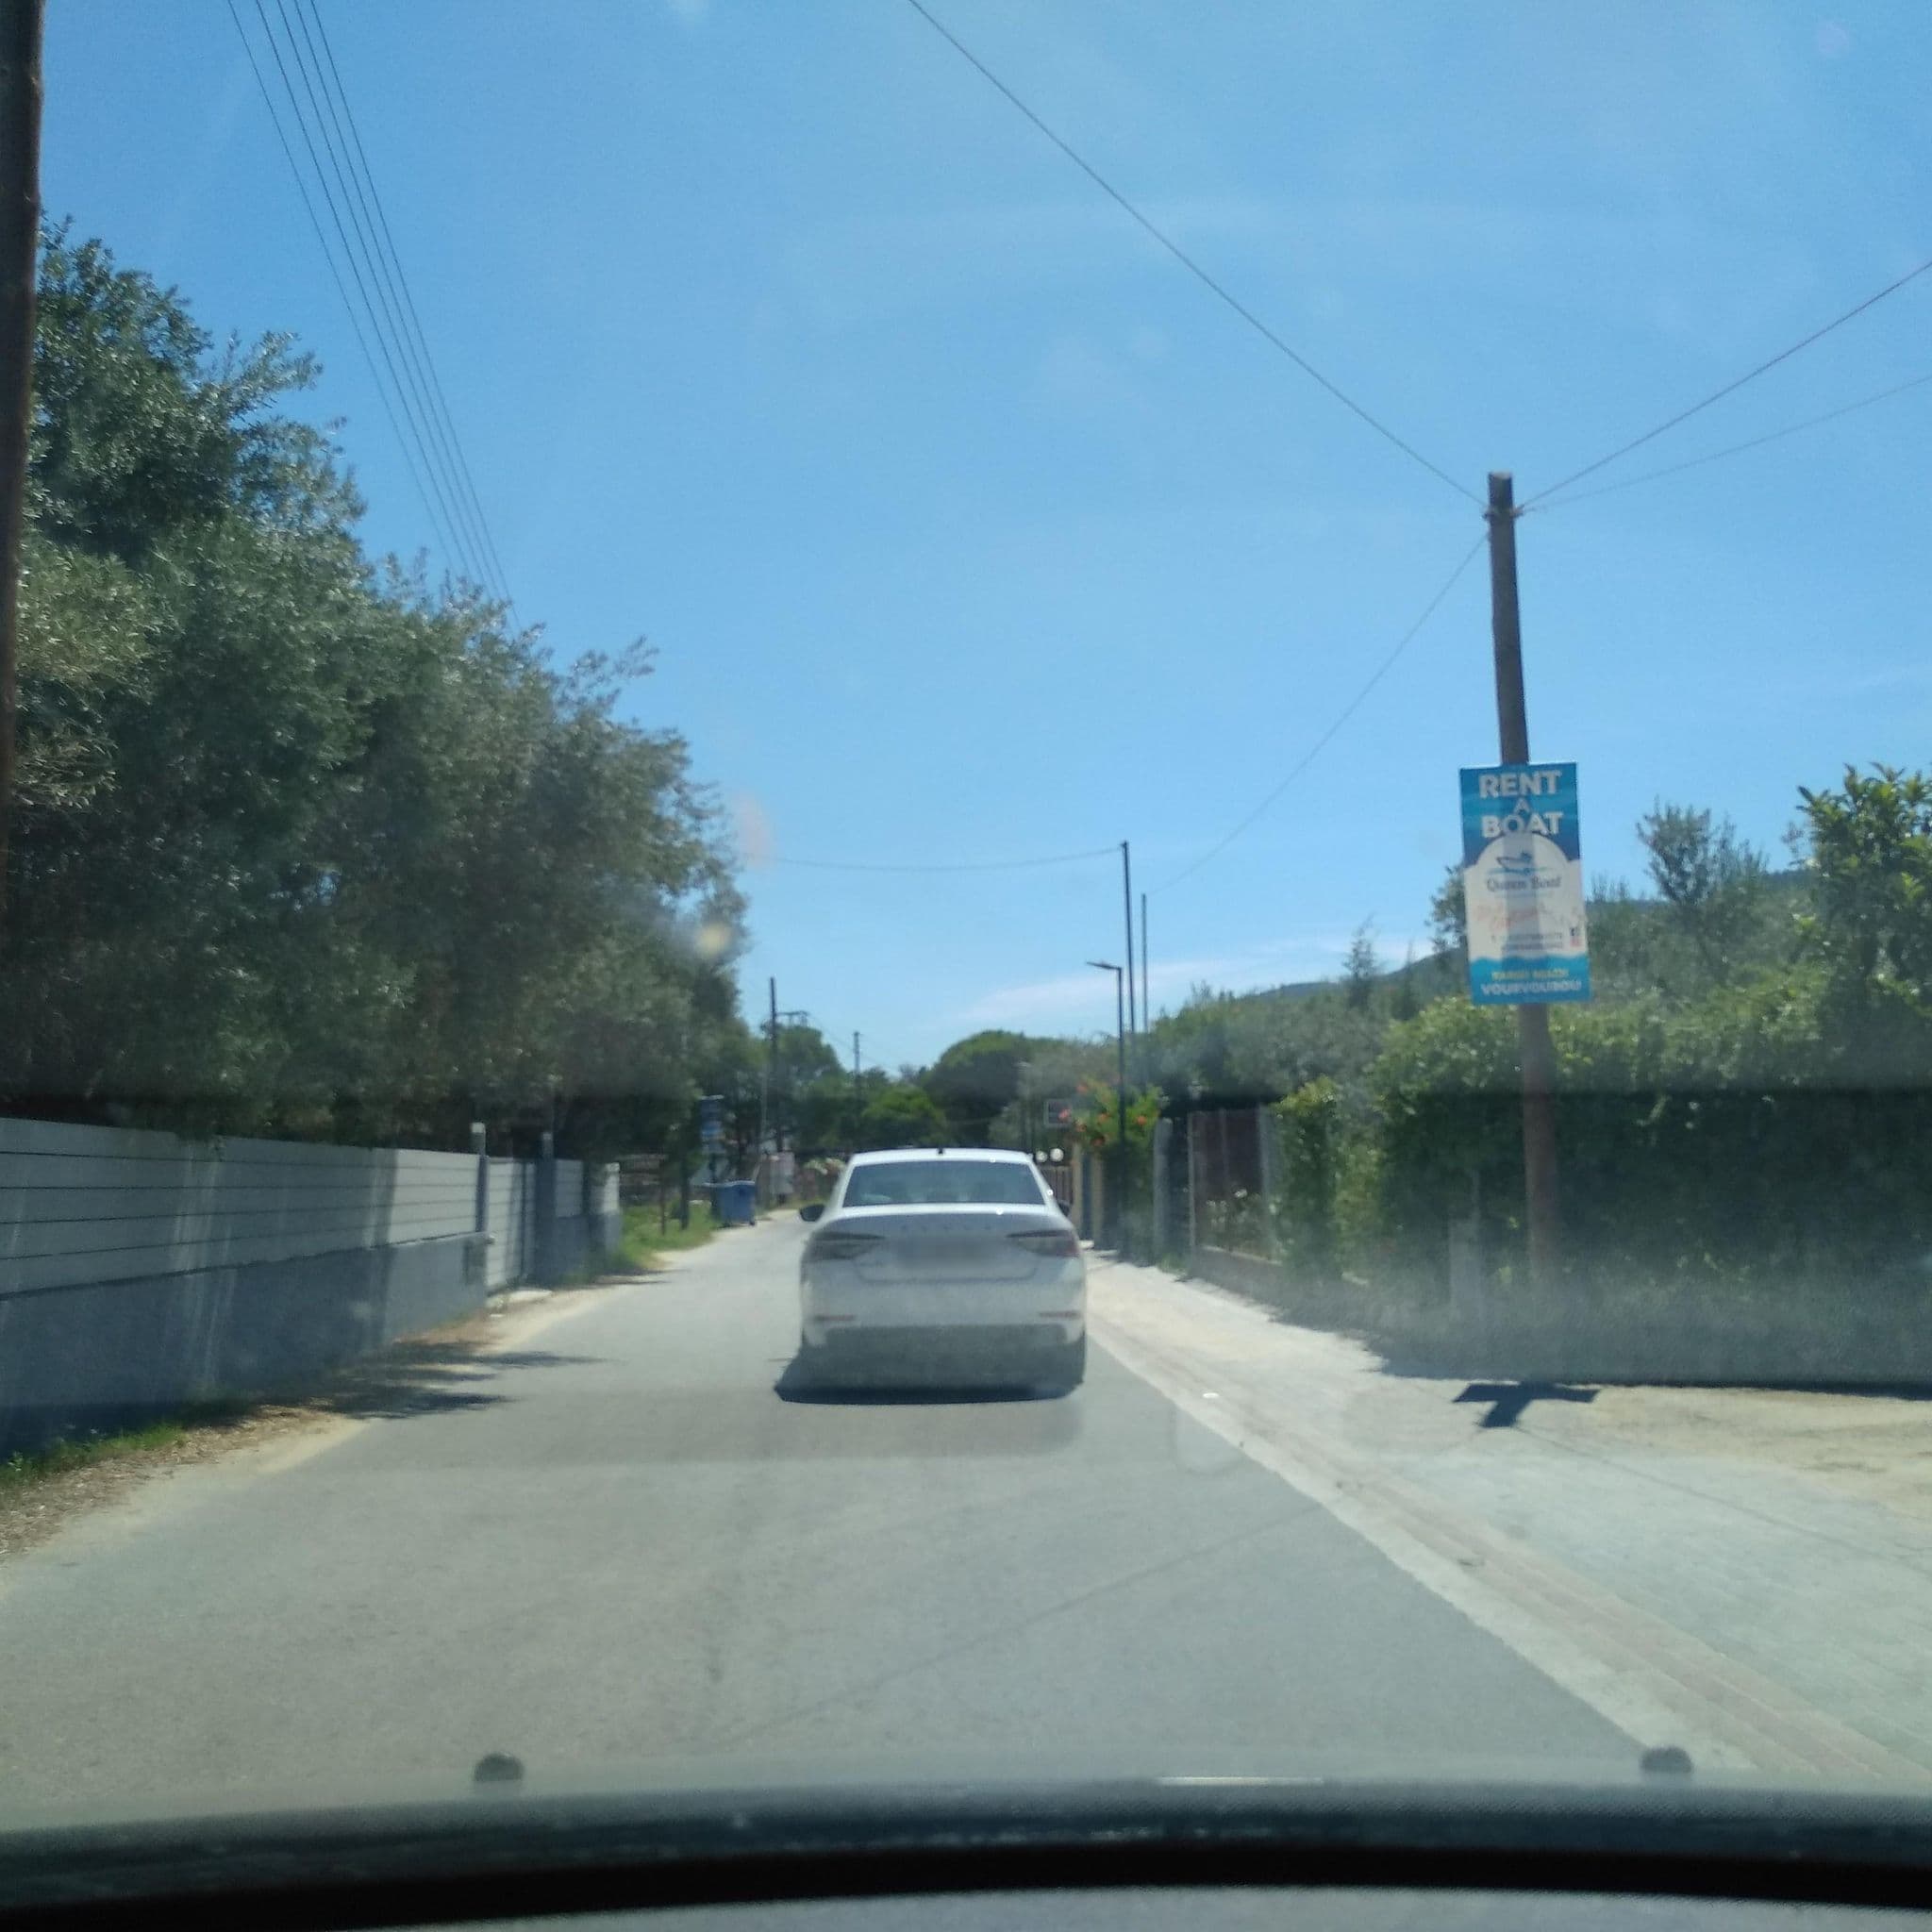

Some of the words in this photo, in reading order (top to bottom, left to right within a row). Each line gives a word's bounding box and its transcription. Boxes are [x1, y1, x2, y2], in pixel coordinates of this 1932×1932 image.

[1479, 770, 1562, 798] RENT
[1513, 797, 1531, 814] A
[1481, 811, 1563, 838] BOAT
